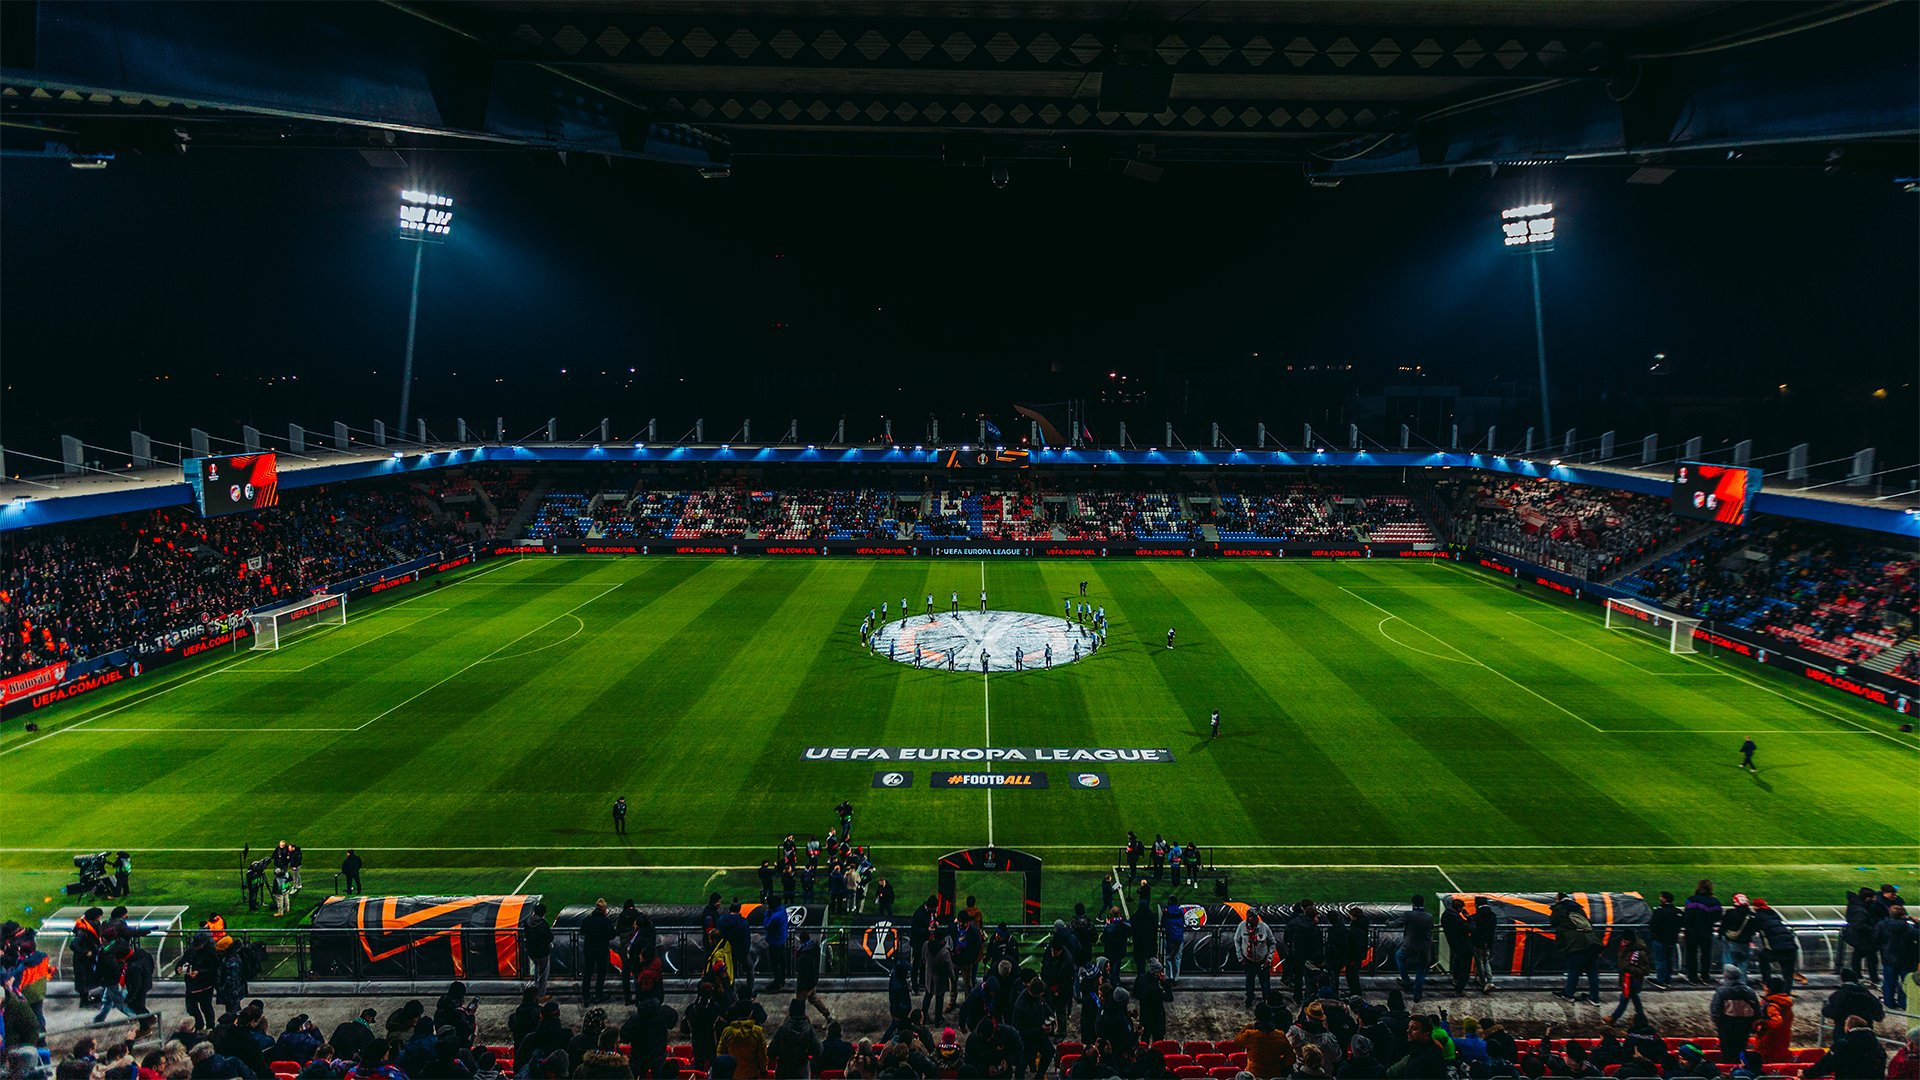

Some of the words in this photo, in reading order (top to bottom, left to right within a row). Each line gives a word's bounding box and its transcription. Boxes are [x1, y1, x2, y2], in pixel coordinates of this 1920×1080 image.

[494, 546, 547, 554] UEFA.COM/UEL
[1399, 550, 1450, 558] UEFA.COM/UEL
[32, 669, 124, 708] UEFA.COM/UEL
[1805, 667, 1888, 705] UEFA.COM/UEL
[806, 748, 890, 760] UEFA
[899, 748, 1026, 761] EUROPA
[947, 775, 1032, 785] #FOOTBALL
